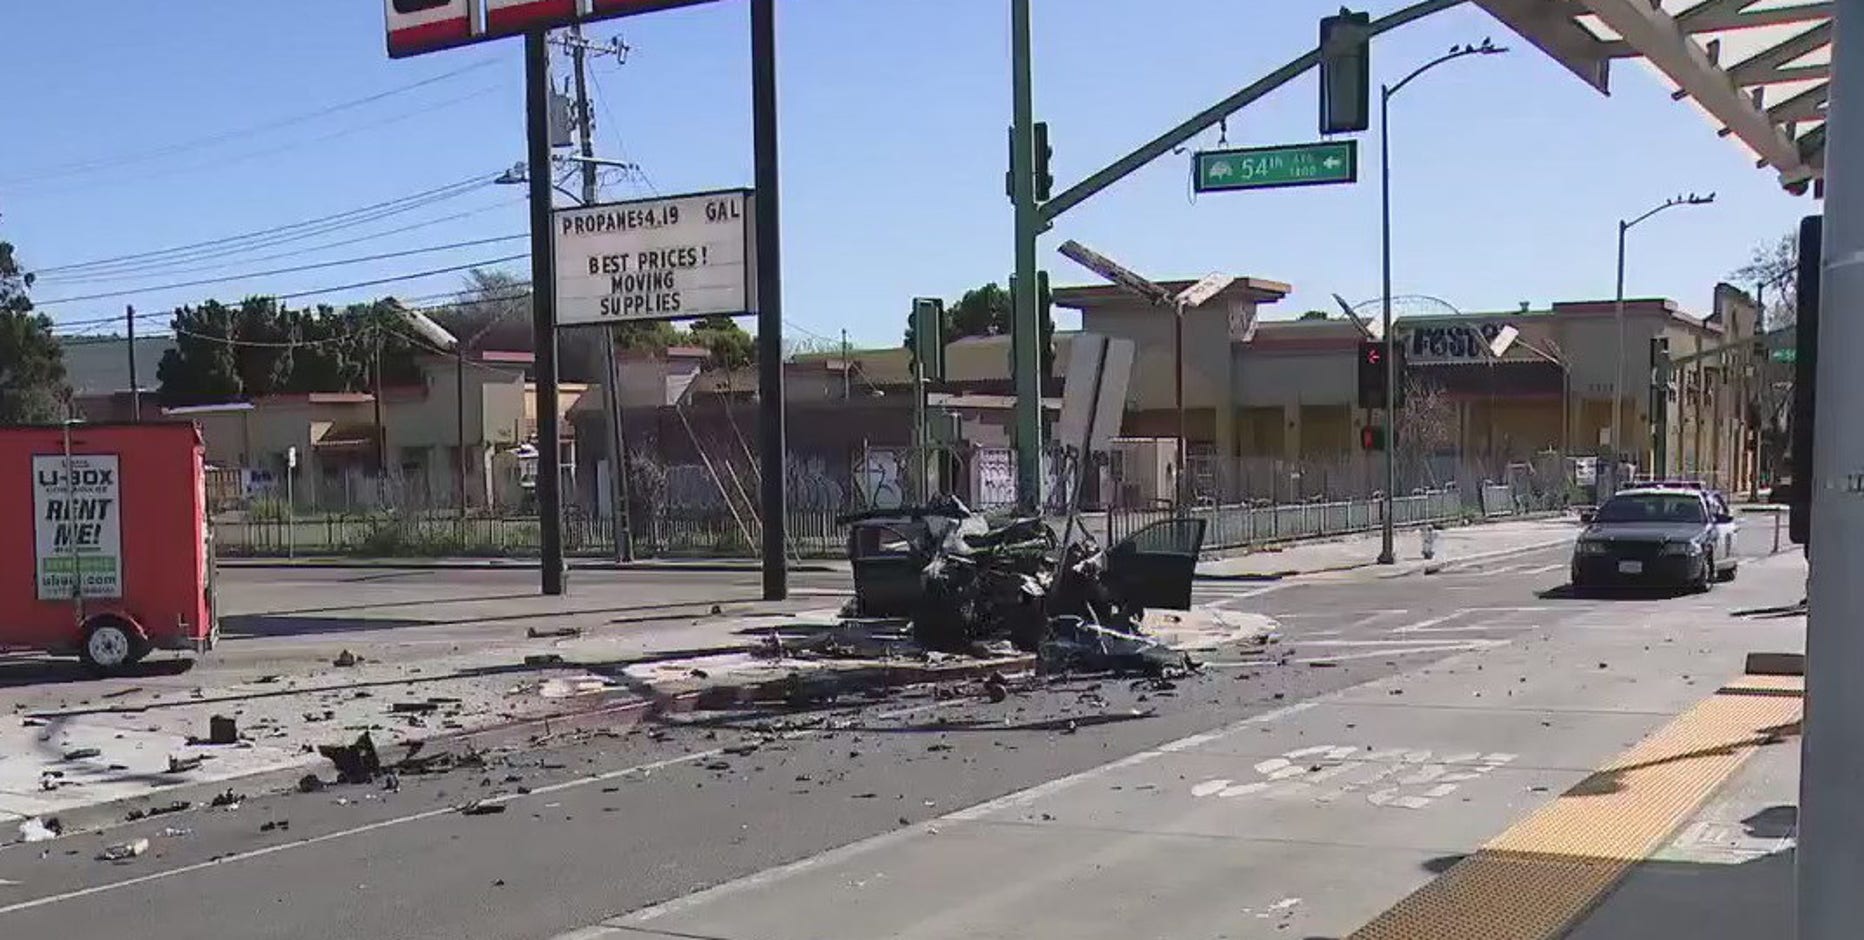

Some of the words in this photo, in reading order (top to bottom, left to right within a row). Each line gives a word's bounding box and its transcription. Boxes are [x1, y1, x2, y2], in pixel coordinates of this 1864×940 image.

[705, 198, 740, 222] GAL
[588, 253, 630, 275] BEST
[610, 271, 675, 295] MOVING
[600, 292, 681, 316] SUPPLIES
[45, 498, 113, 521] RENT
[54, 523, 102, 546] ME!
